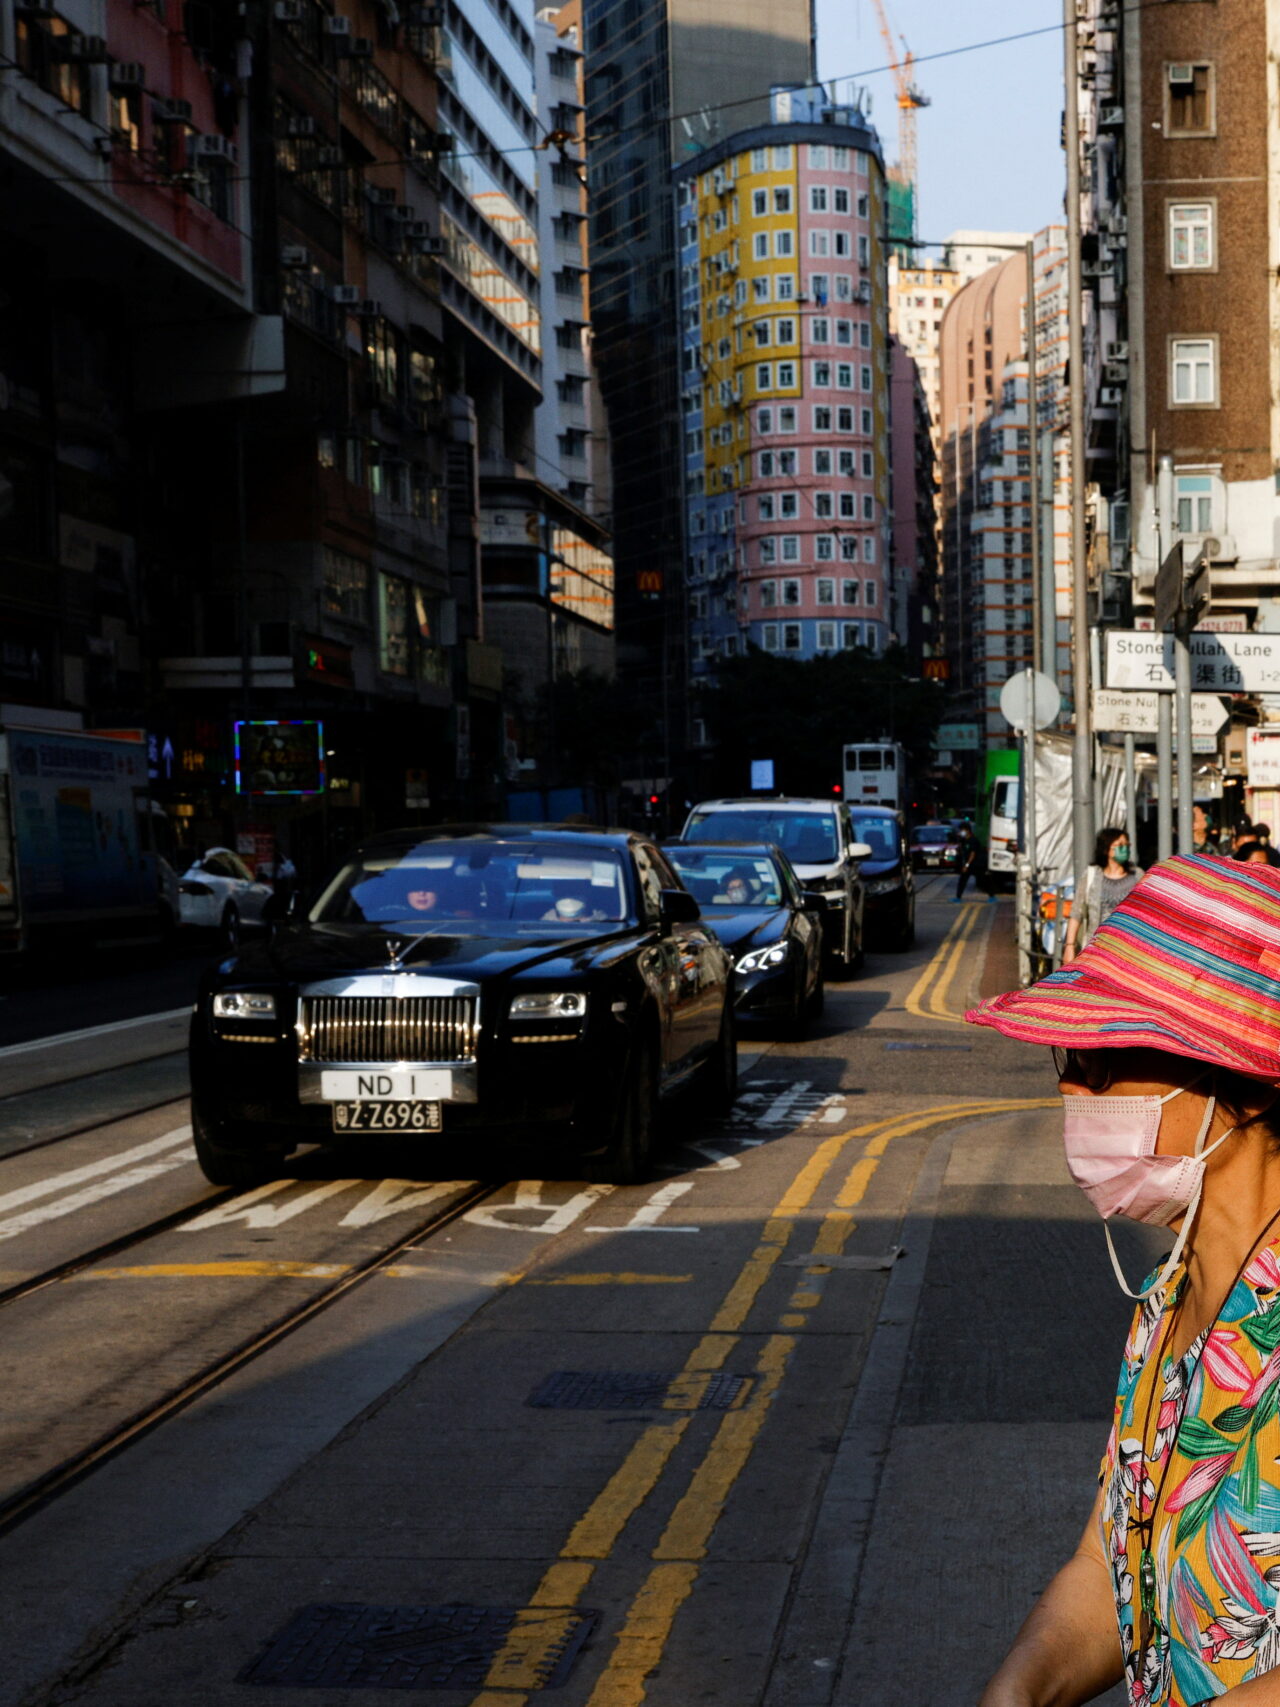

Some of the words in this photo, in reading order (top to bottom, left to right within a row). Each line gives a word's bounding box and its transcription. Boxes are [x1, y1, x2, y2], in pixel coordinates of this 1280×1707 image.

[1116, 639, 1165, 656] Stone
[1234, 642, 1273, 657] Lane
[1145, 663, 1241, 685] 石渠街
[1097, 695, 1132, 707] Stone
[357, 1075, 393, 1096] ND
